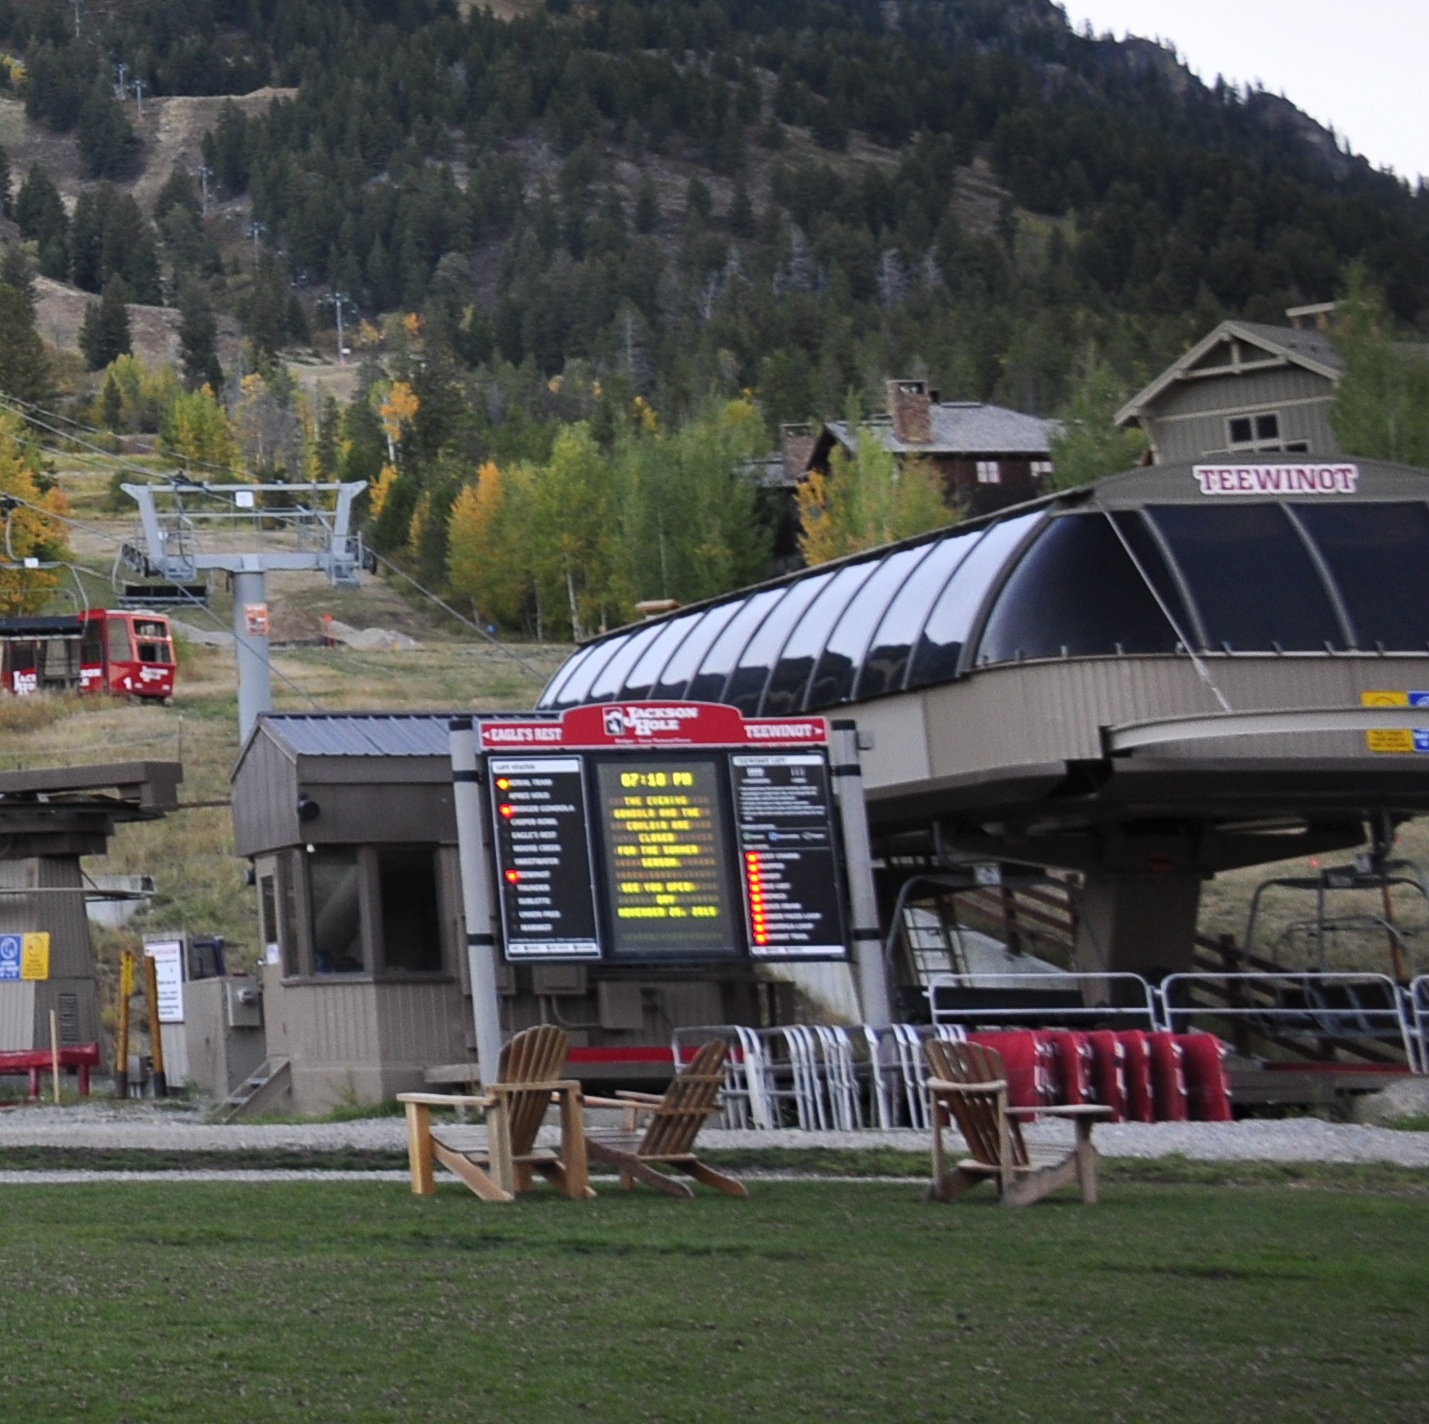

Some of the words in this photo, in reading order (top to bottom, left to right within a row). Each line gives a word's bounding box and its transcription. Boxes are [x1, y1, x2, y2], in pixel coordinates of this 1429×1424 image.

[1196, 466, 1356, 492] TEEWINOT
[623, 706, 698, 728] JACKSON
[491, 727, 533, 742] EAGLE'S
[534, 727, 562, 741] REST
[635, 719, 680, 736] HOLE
[744, 723, 813, 738] TEEWINOT
